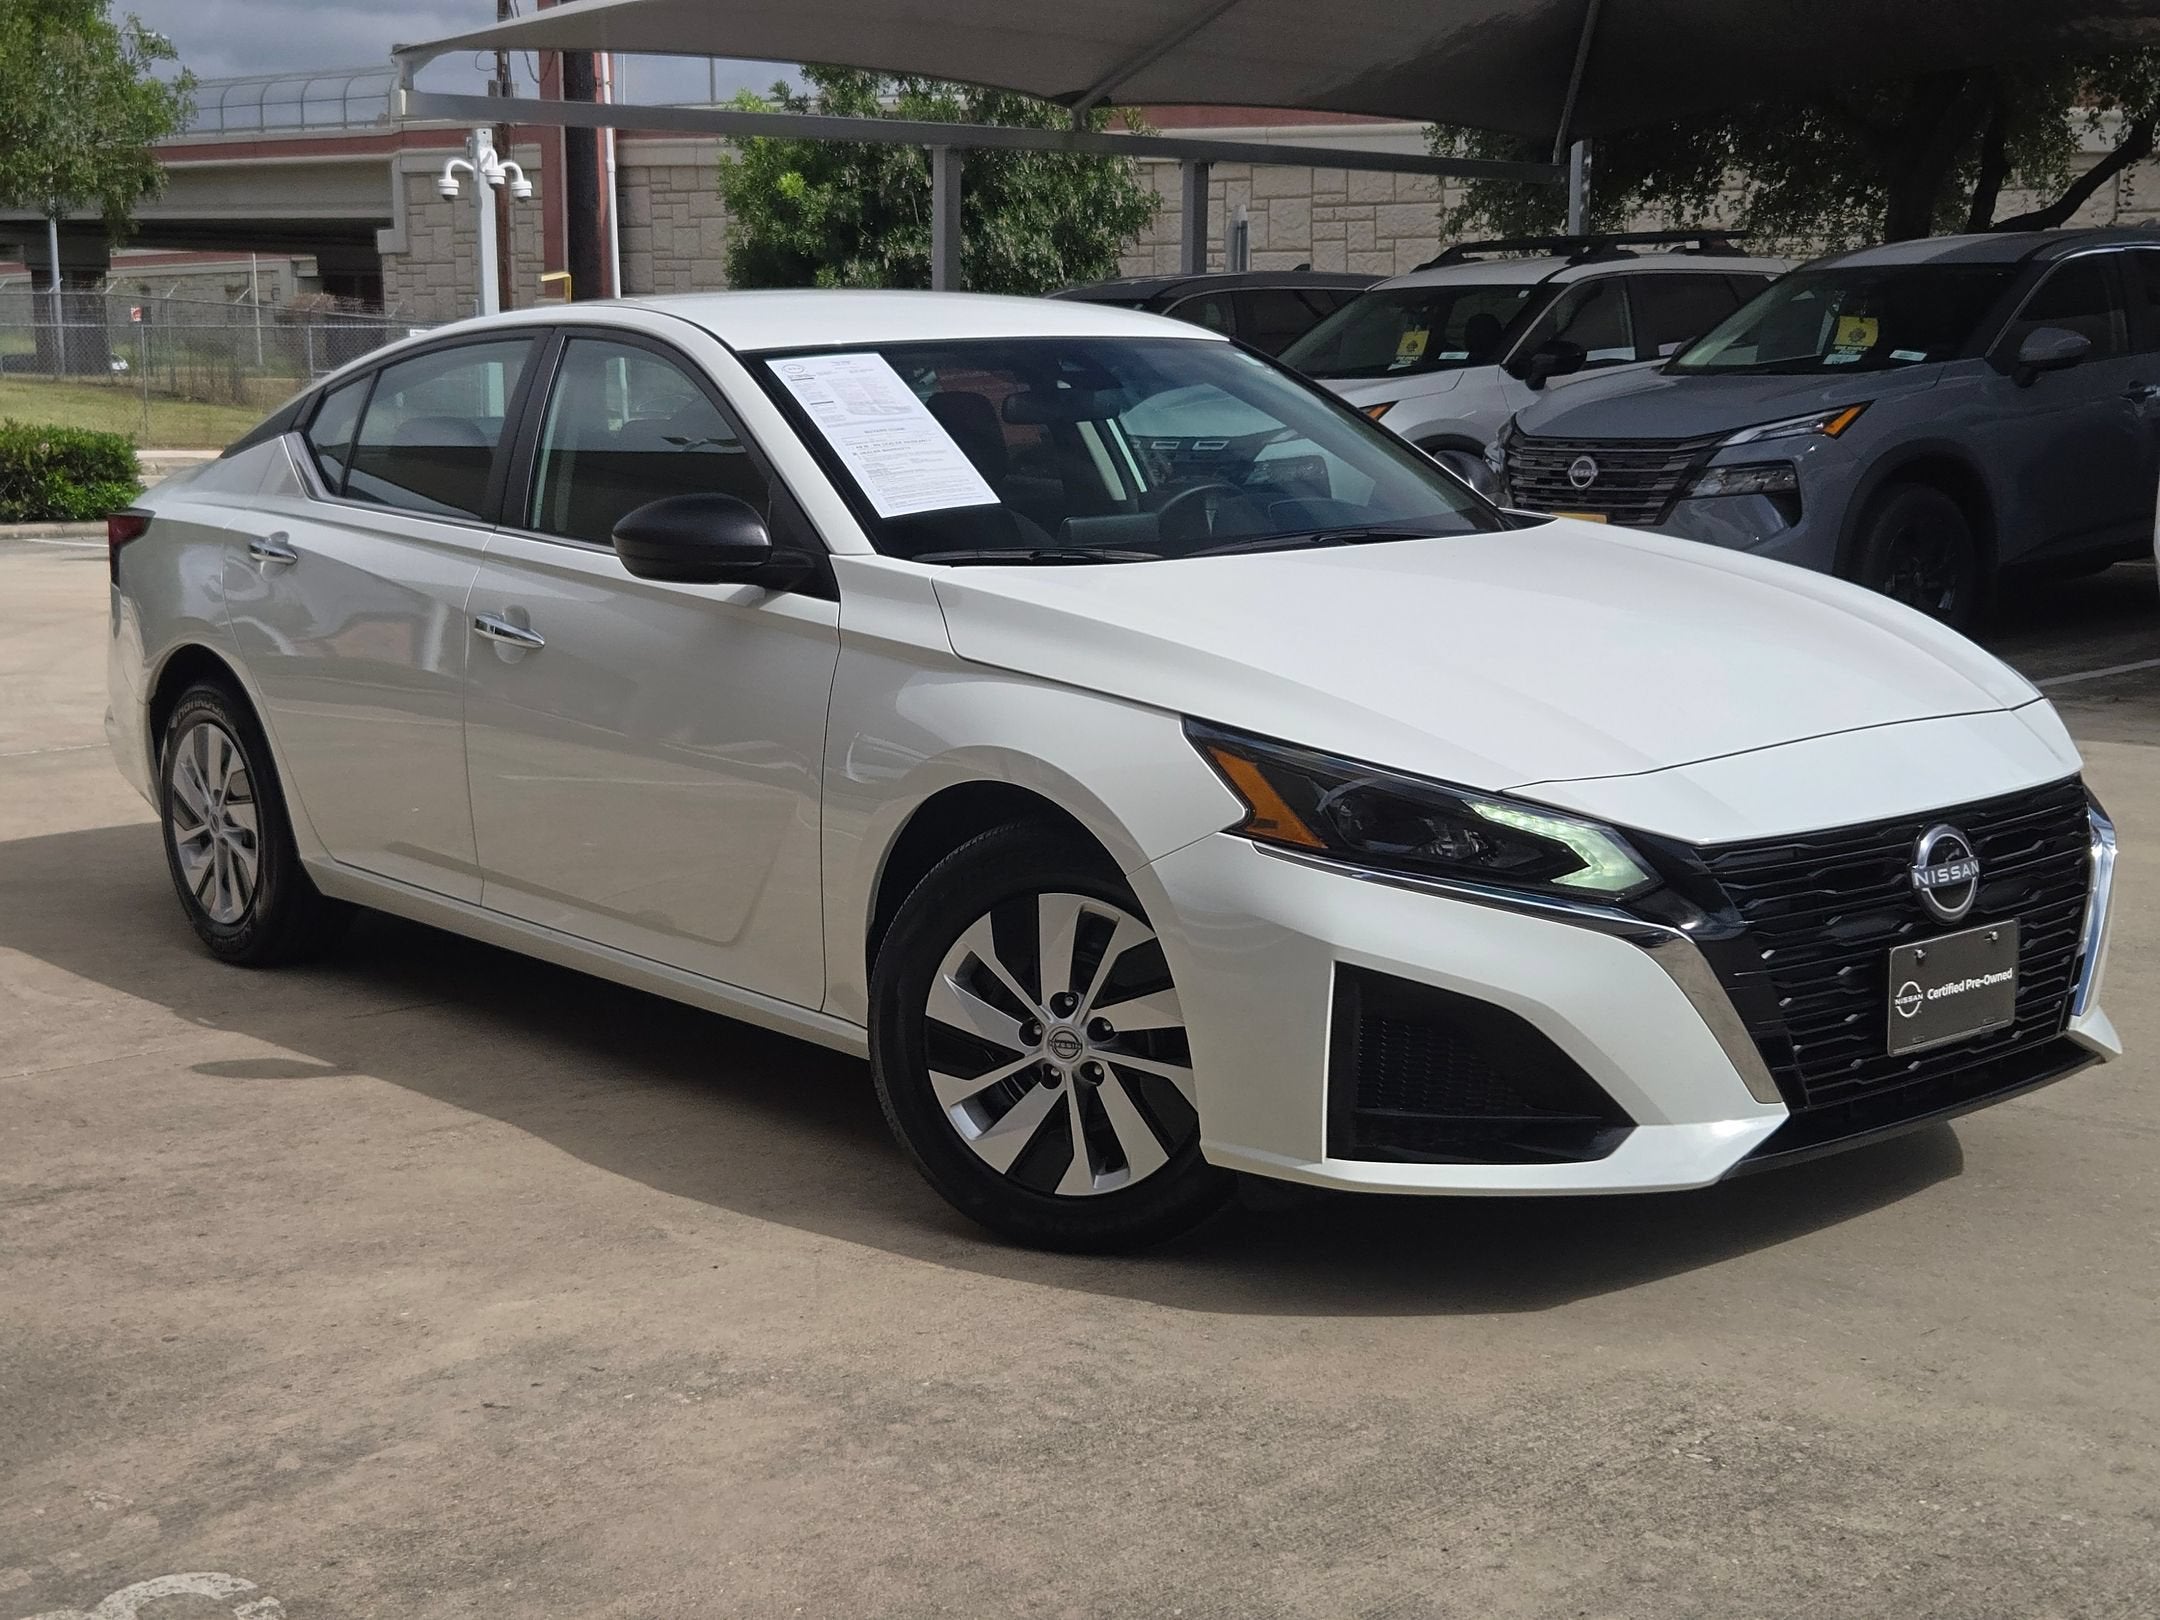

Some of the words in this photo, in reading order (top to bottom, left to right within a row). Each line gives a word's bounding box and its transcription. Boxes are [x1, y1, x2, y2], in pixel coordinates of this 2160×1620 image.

[1914, 859, 1979, 886] NISSAN
[1927, 980, 1965, 1000] Certified
[1966, 967, 2013, 990] Pre-Owned
[1895, 993, 1924, 1005] NISSAN
